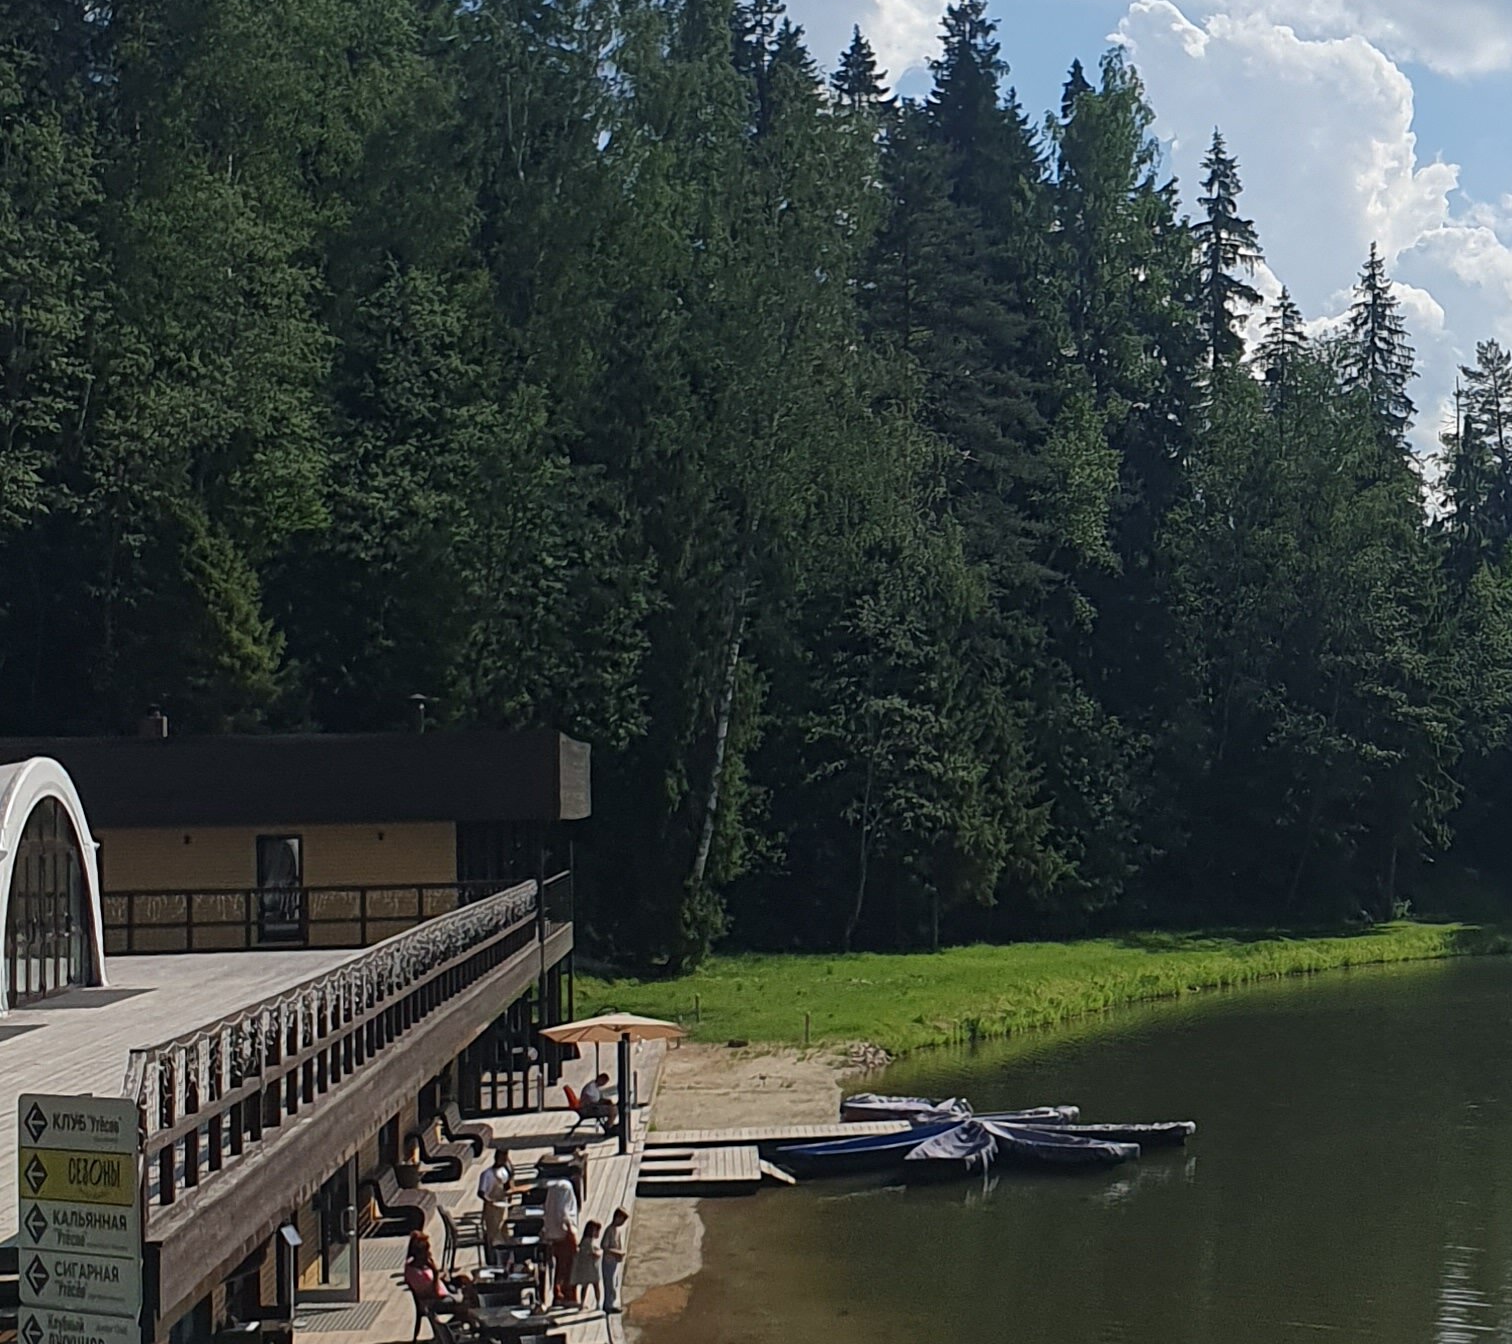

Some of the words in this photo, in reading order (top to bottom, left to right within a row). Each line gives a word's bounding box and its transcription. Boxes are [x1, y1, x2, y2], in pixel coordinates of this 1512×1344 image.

[52, 1112, 86, 1132] КЛУБ
[68, 1157, 120, 1188] СЕЗОНЫ
[52, 1209, 127, 1232] КАЛЬЯННАЯ
[54, 1260, 119, 1283] СИГАРНАЯ
